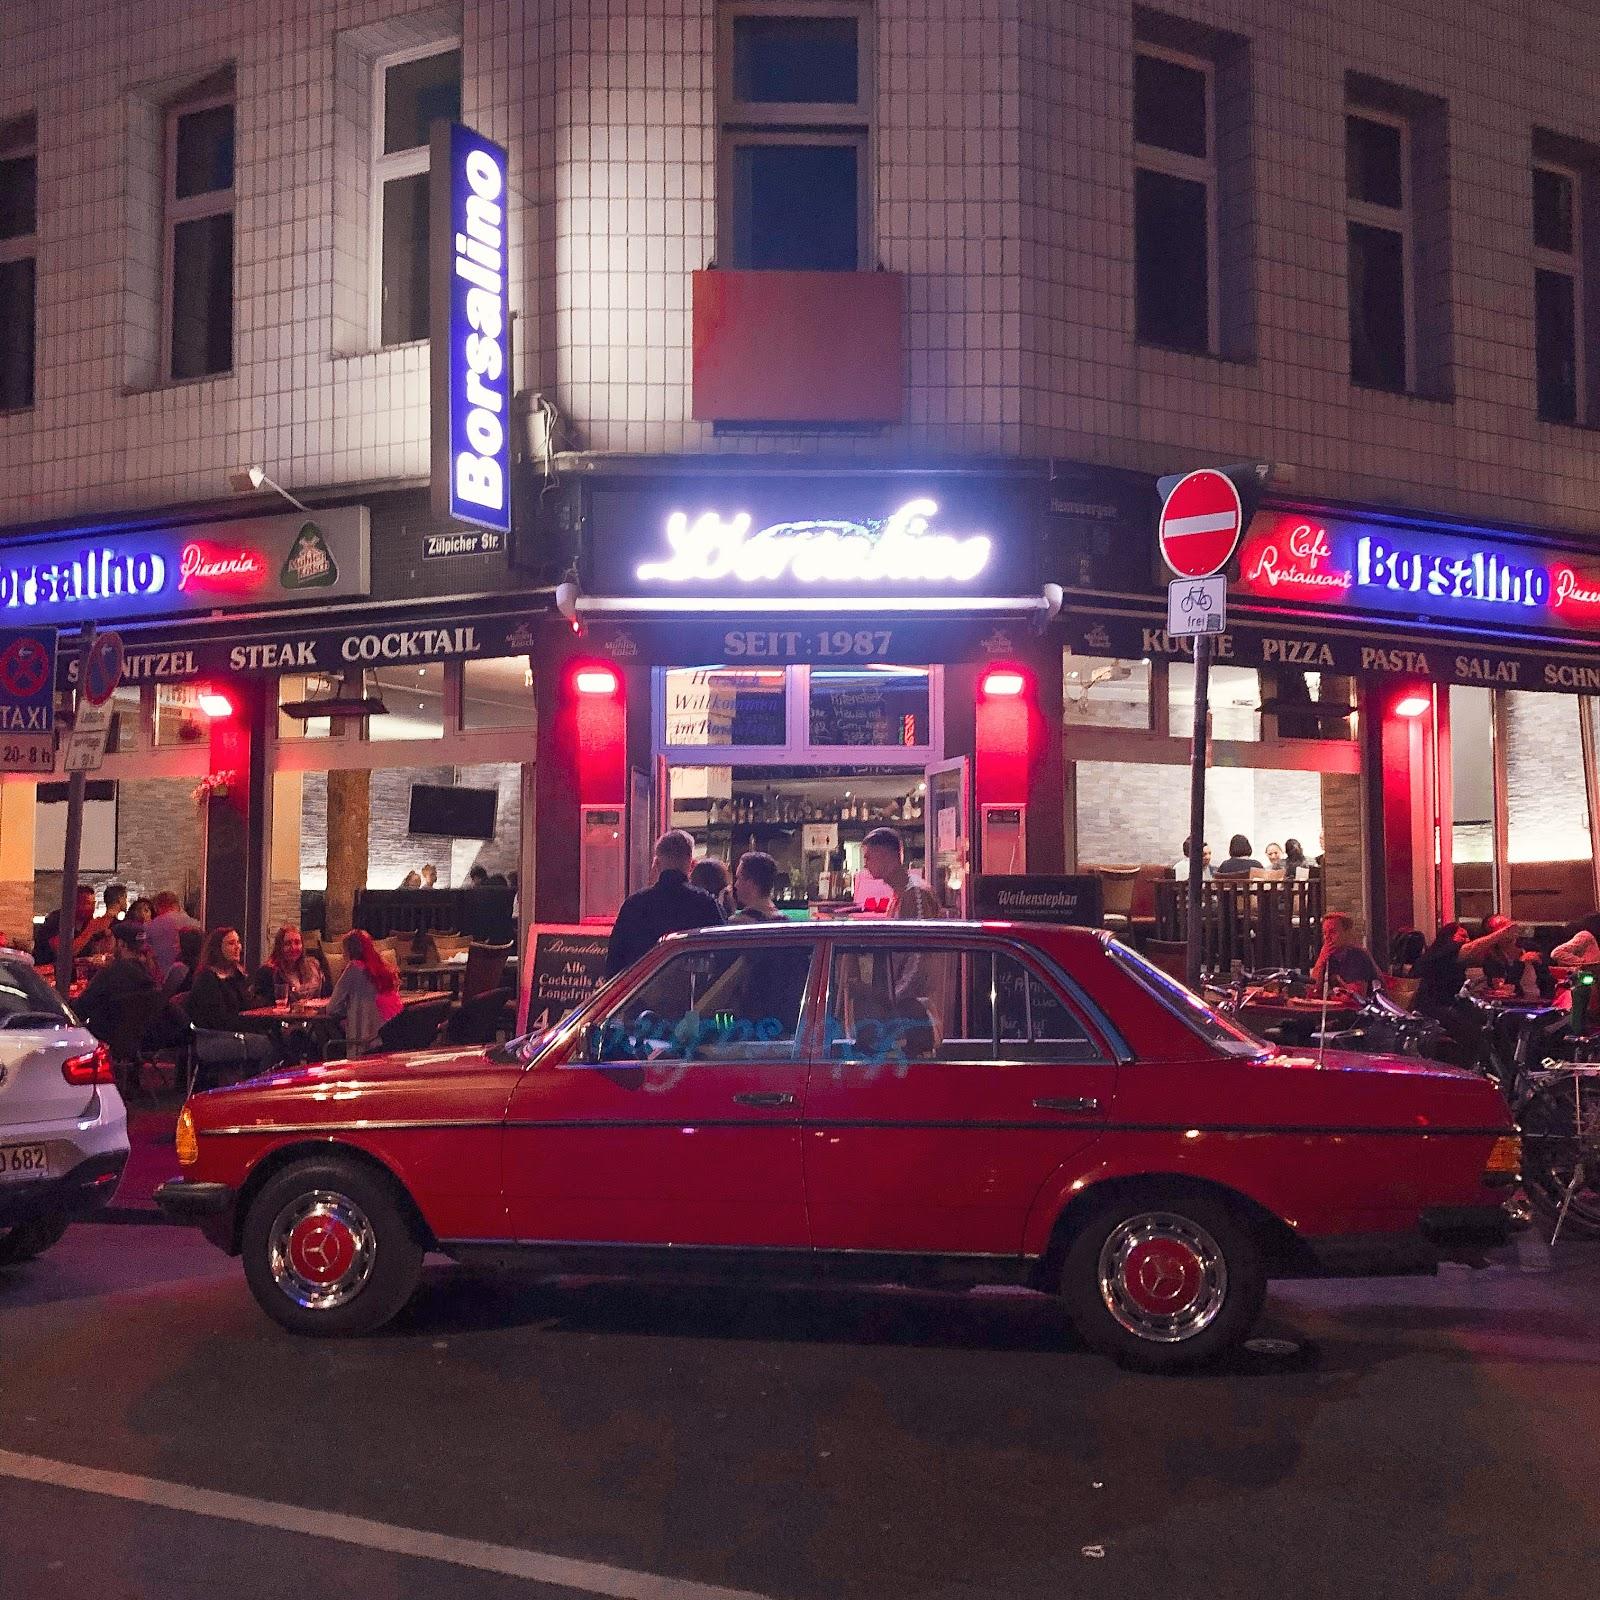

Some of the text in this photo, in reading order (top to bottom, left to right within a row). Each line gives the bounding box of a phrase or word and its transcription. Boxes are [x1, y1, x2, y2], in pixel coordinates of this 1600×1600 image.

[456, 149, 503, 511] Borsalino
[428, 533, 499, 555] Zülpicher Str.
[1290, 525, 1332, 569] Cafe
[178, 543, 258, 591] Pizzeria
[1248, 545, 1352, 588] Restaurant
[1358, 536, 1550, 606] Borsalino
[1188, 615, 1204, 627] frei
[67, 626, 481, 683] SNITZEL STEAK COCKTAIL
[1262, 638, 1335, 666] PIZZA
[1361, 647, 1431, 674] PASTA
[1455, 655, 1520, 683] SALAT
[1, 705, 47, 729] TAXI
[998, 890, 1078, 907] Weihenstephan
[539, 973, 592, 987] Cocktails
[563, 961, 586, 974] Alle
[11, 1147, 45, 1171] 682
